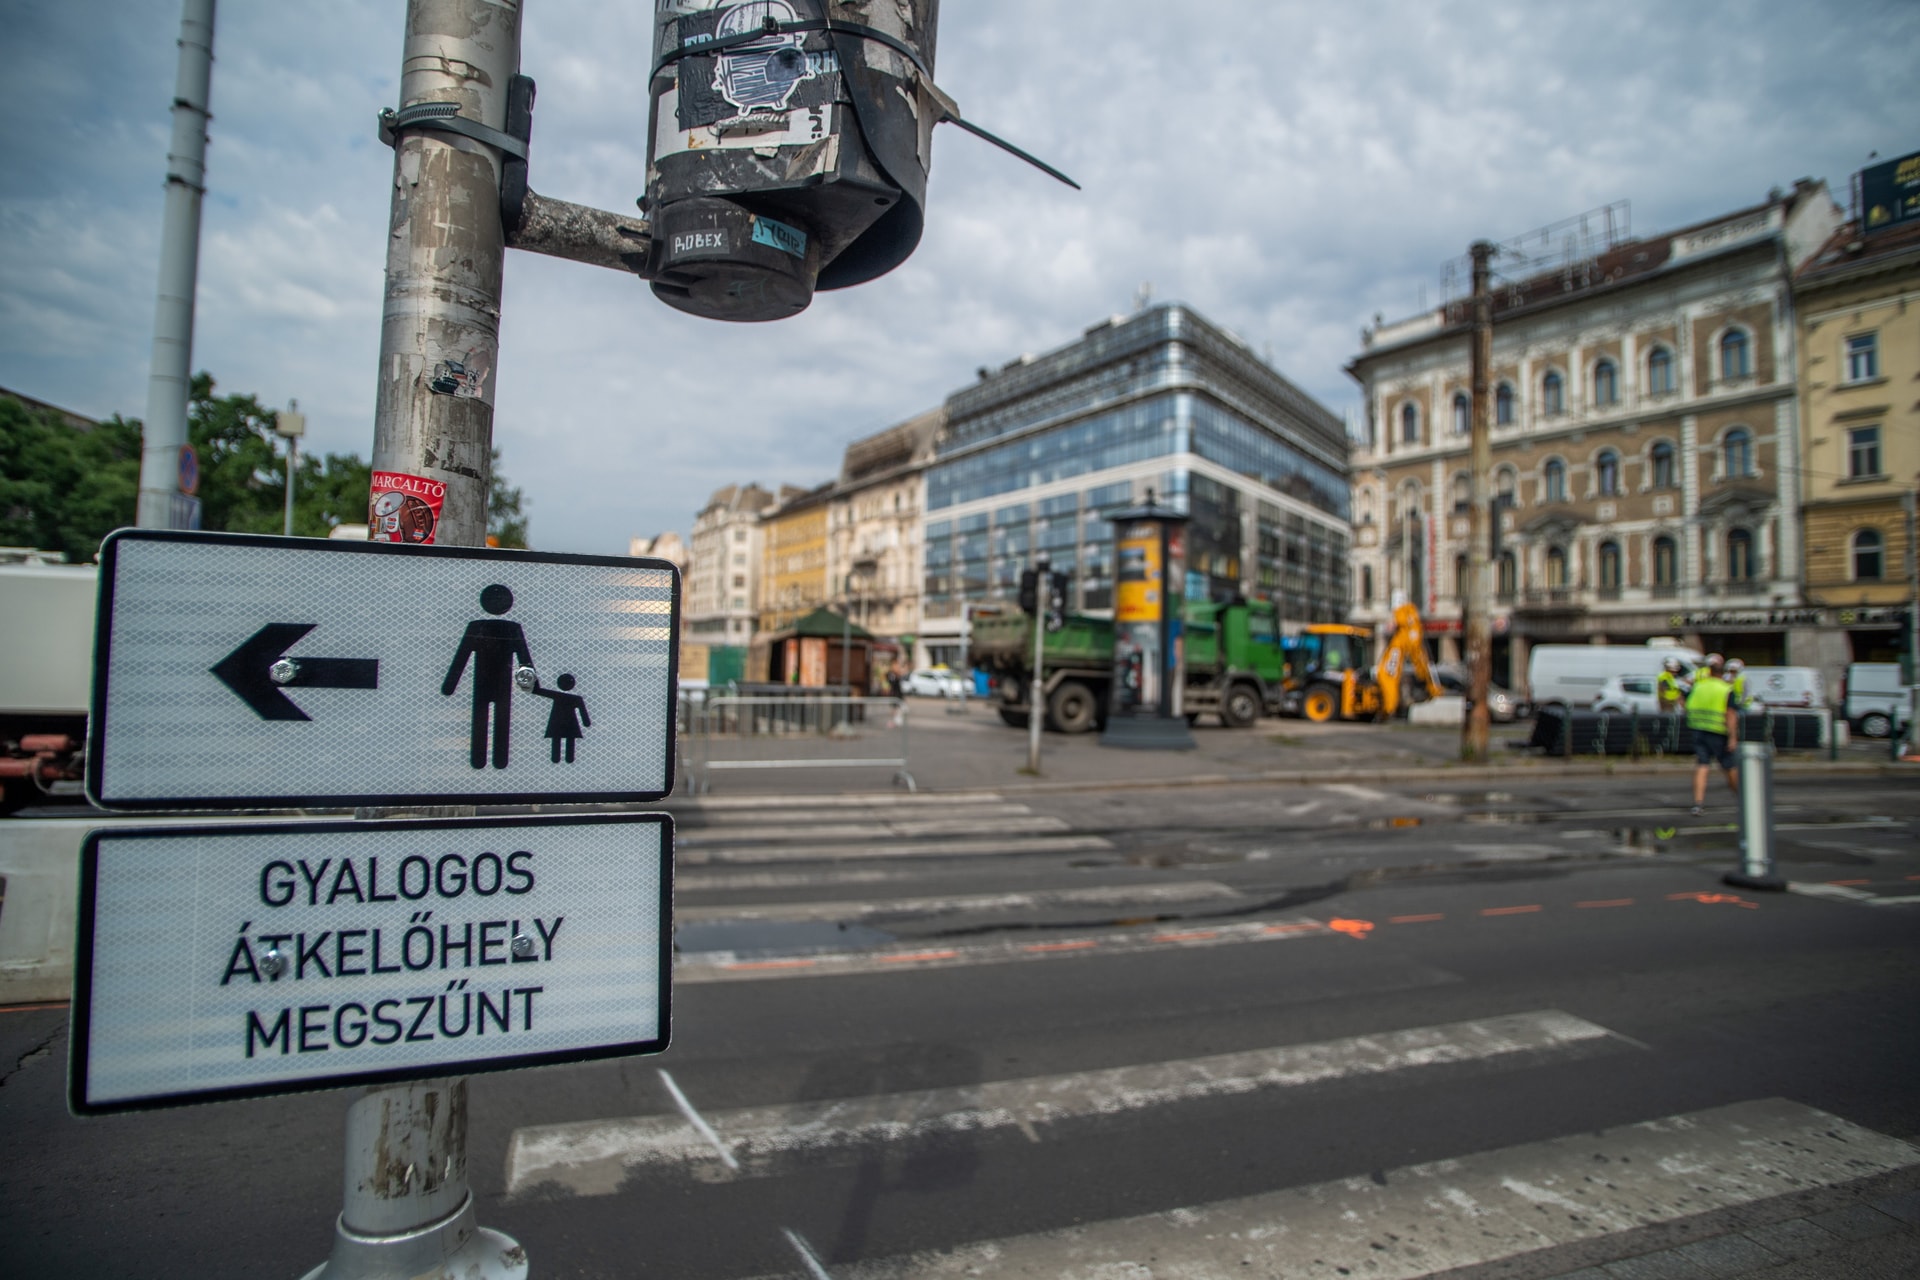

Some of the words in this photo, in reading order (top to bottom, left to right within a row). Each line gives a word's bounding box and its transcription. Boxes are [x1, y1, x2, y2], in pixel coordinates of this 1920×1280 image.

[258, 850, 535, 907] GYALOGOS
[219, 912, 564, 986] ÁTKELŐHELY
[245, 980, 544, 1058] MEGSZŰNT
